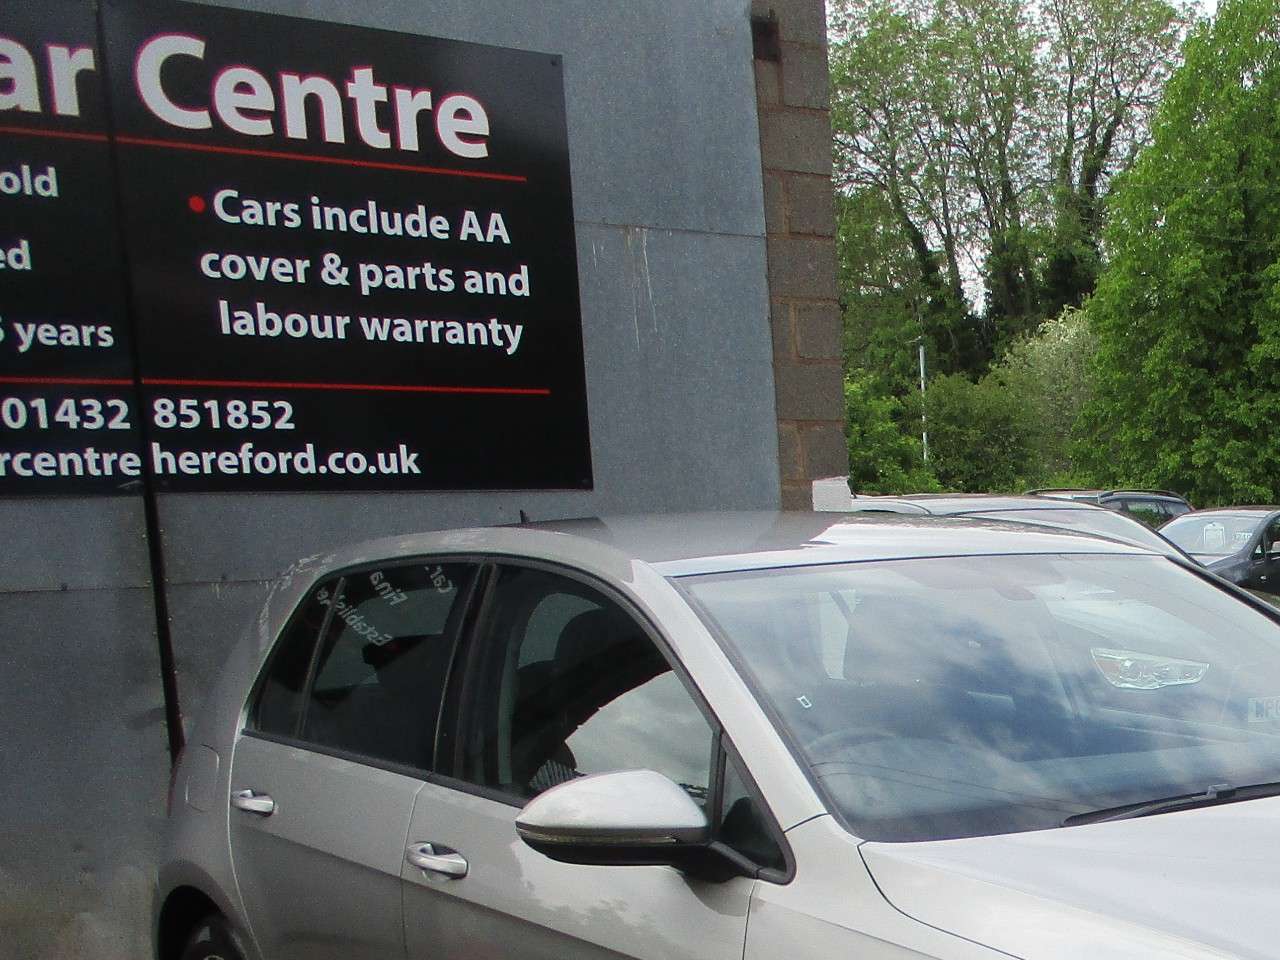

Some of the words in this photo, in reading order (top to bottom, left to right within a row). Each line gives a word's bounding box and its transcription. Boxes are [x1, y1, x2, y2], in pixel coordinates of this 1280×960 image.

[0, 37, 96, 117] ar
[136, 34, 490, 158] Centre
[0, 165, 58, 196] old
[214, 190, 301, 227] Cars
[311, 196, 449, 239] include
[460, 211, 510, 243] AA
[0, 240, 31, 269] d
[201, 253, 310, 283] cover
[321, 253, 350, 285] &
[359, 263, 455, 295] parts
[464, 265, 529, 296] and
[14, 323, 113, 352] years
[219, 300, 350, 339] labour
[359, 317, 523, 355] warranty
[2, 398, 130, 429] 01432
[154, 399, 294, 429] 851852
